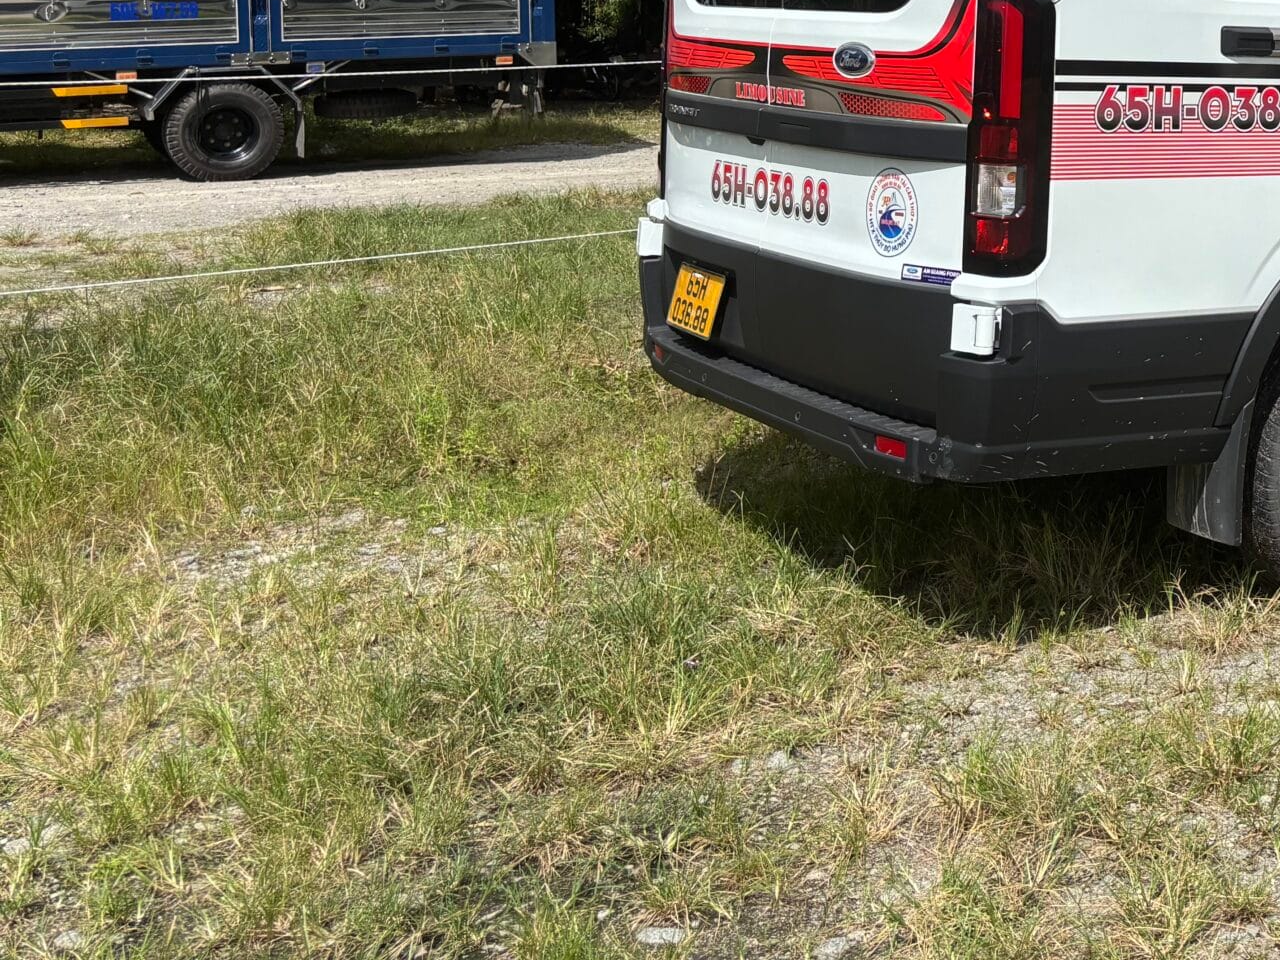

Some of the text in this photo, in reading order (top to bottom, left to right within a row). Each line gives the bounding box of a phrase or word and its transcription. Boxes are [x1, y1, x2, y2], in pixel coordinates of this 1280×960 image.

[839, 50, 862, 69] Ford
[735, 81, 805, 107] LIMOUSINE
[711, 160, 830, 226] 65H-038.88
[686, 271, 710, 301] 65H
[672, 297, 710, 334] 038.88
